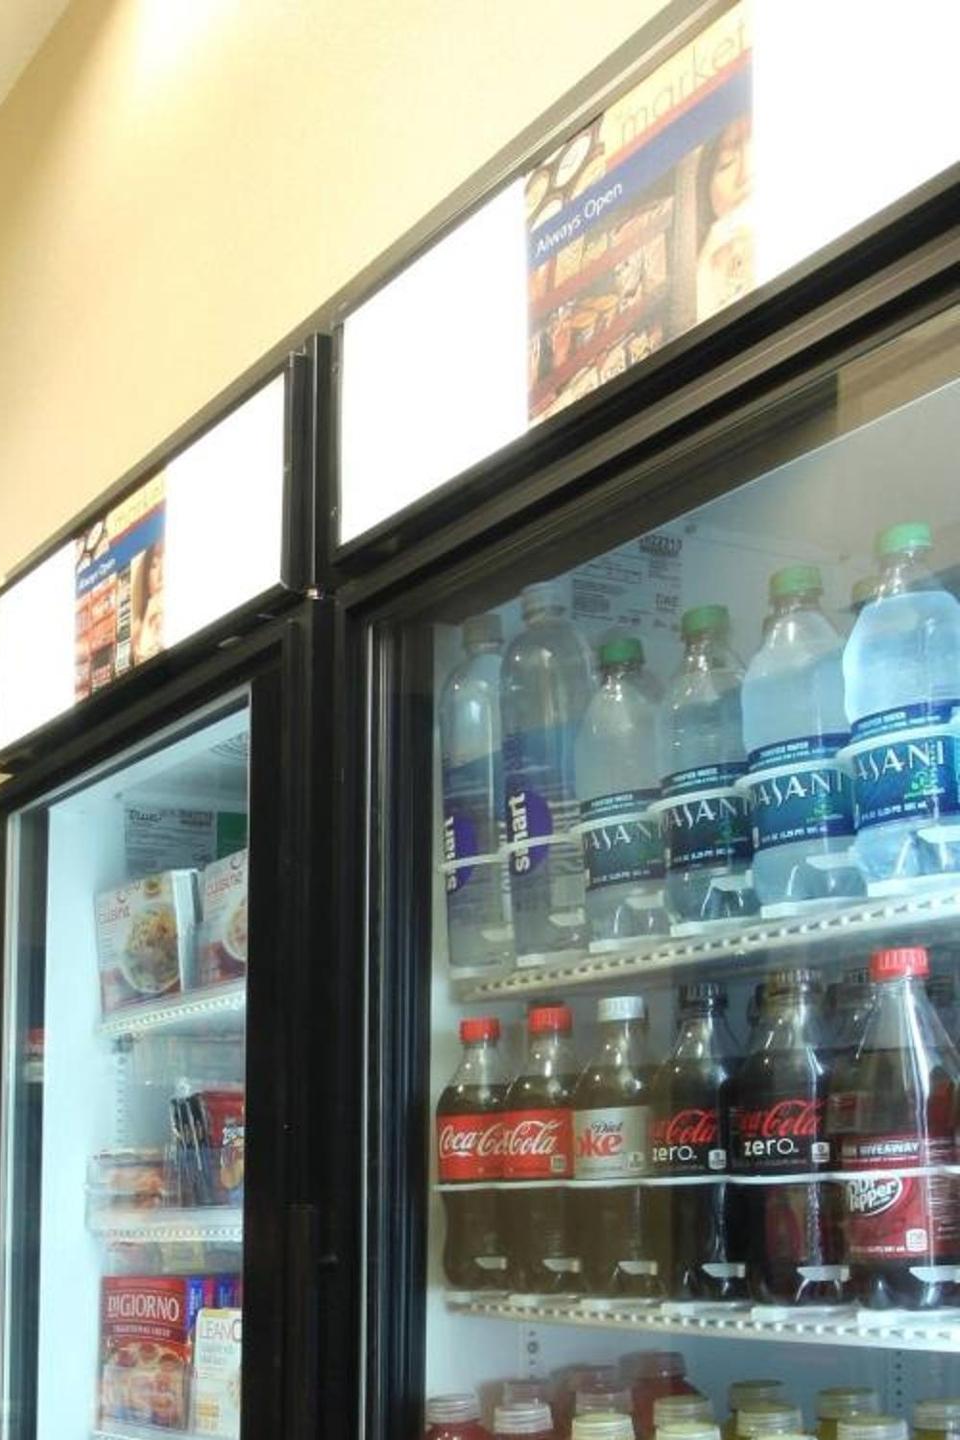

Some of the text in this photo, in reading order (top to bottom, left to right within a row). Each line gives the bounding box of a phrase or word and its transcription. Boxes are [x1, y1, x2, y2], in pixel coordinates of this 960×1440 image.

[534, 183, 623, 257] Always Open
[857, 740, 944, 781] ASANI
[444, 816, 457, 891] sart
[653, 1145, 693, 1161] zero
[745, 1138, 794, 1156] zero
